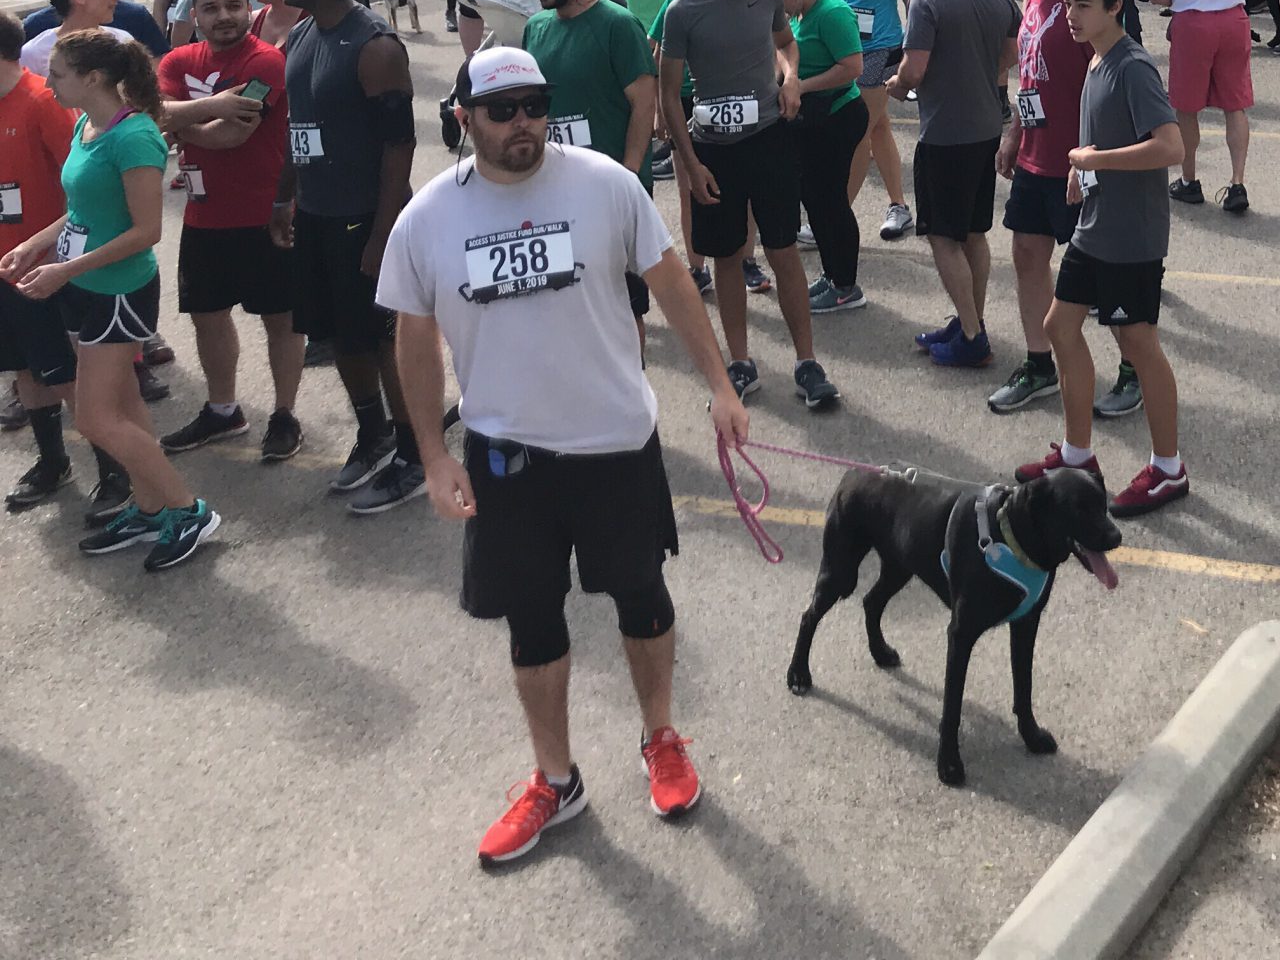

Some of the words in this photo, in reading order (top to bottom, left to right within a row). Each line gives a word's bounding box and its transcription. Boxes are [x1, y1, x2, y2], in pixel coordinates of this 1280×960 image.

[709, 102, 744, 125] 263
[1019, 97, 1036, 119] 64
[468, 237, 489, 248] ACCESS
[489, 235, 496, 243] TO
[496, 230, 517, 242] JUSTICE
[518, 227, 532, 238] FUND
[533, 223, 563, 236] RUN/WALK
[489, 238, 549, 282] 258
[497, 283, 516, 296] JUNE
[526, 275, 548, 289] 2019
